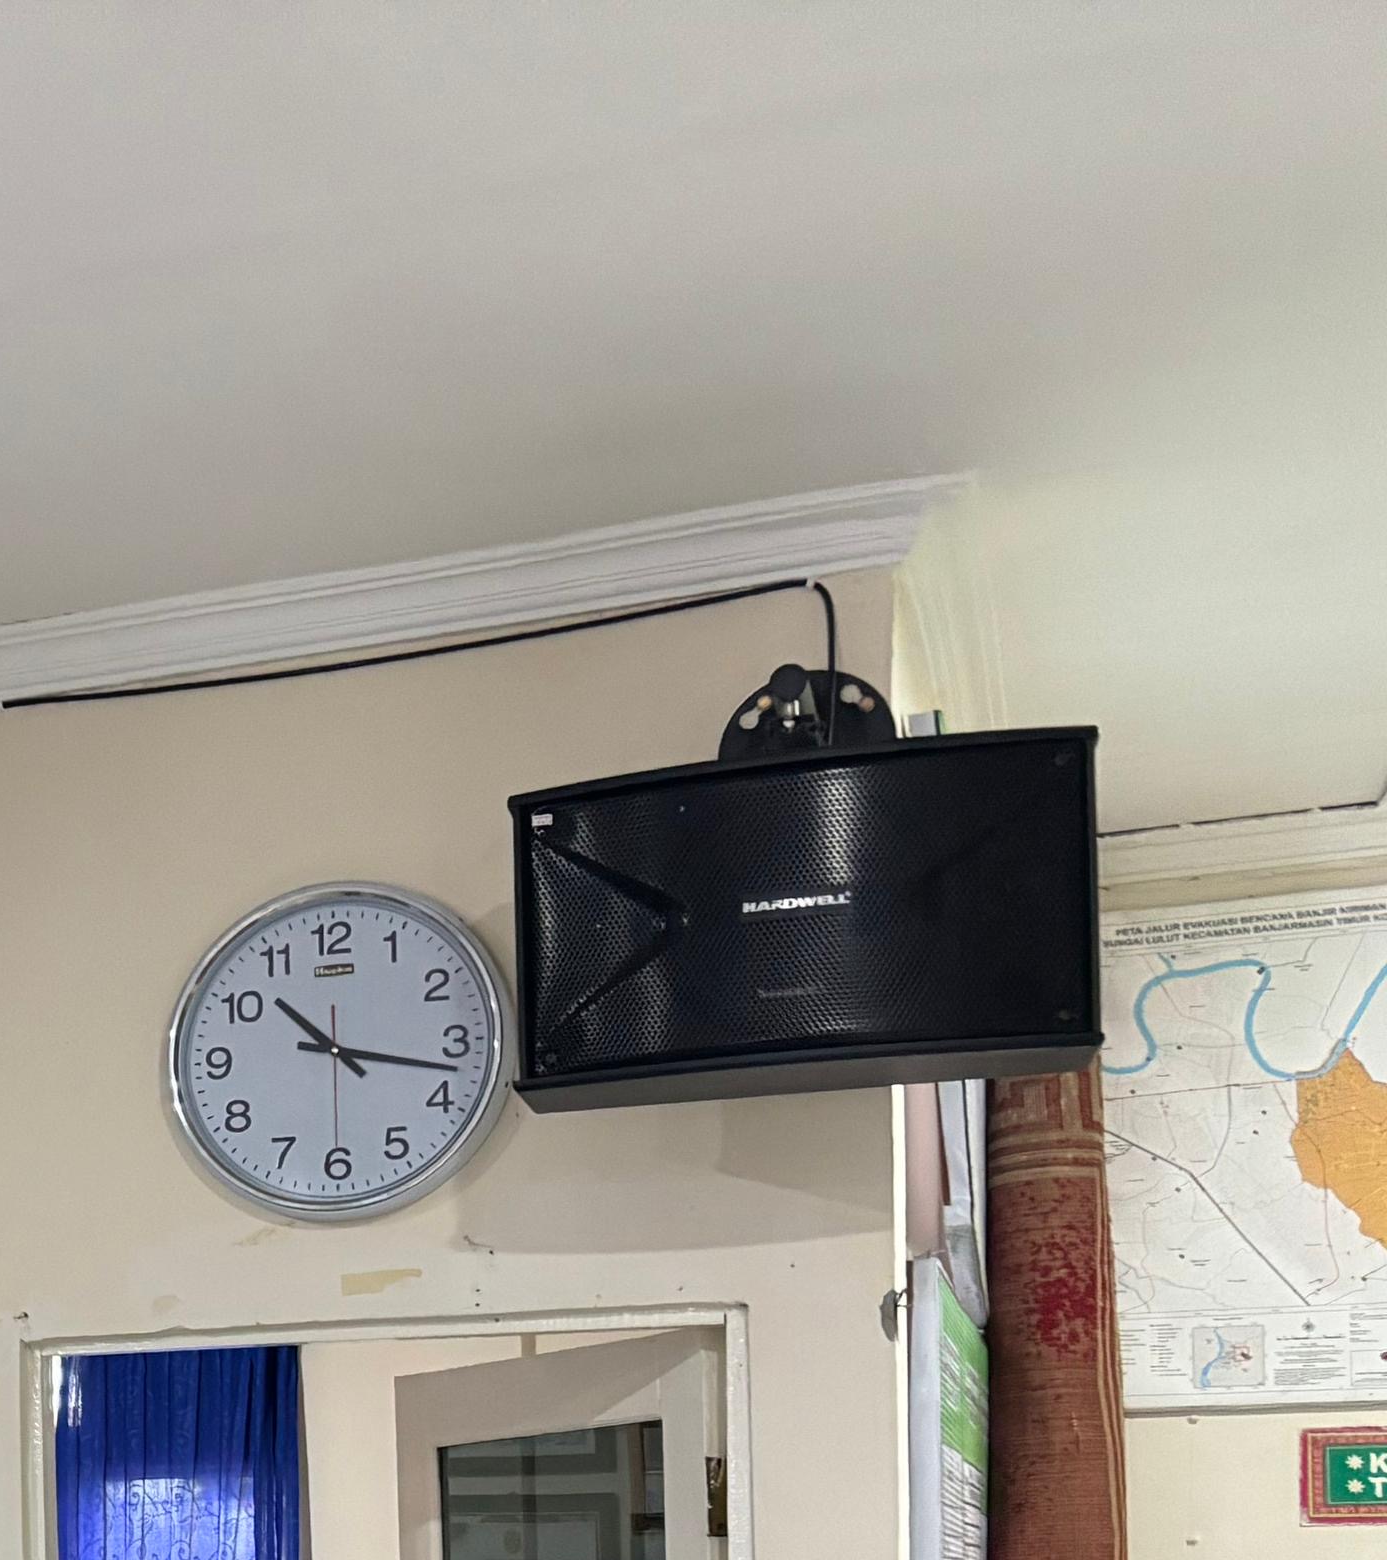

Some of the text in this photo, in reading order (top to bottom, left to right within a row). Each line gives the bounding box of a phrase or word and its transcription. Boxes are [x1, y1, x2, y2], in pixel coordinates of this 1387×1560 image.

[742, 893, 850, 913] HARDWELL
[311, 921, 353, 956] 12
[1115, 926, 1143, 937] PETA
[1145, 922, 1181, 935] JALUR
[1183, 917, 1238, 931] EVAKUASI
[1240, 911, 1294, 926] BENCANA
[1296, 907, 1337, 920] BANJIR
[1145, 933, 1181, 946] LULUT
[1183, 927, 1250, 941] KECAMATAN
[1252, 918, 1333, 934] BANJARMASIN
[1336, 915, 1371, 926] TIMUR
[260, 943, 291, 978] 11
[383, 930, 398, 963] 1
[424, 968, 450, 1002] 2
[221, 990, 263, 1024] 10
[442, 1024, 471, 1059] 3
[205, 1047, 233, 1080] 9
[425, 1080, 455, 1114] 4
[224, 1100, 252, 1133] 8
[271, 1136, 297, 1170] 7
[383, 1126, 410, 1160] 5
[324, 1147, 352, 1180] 6
